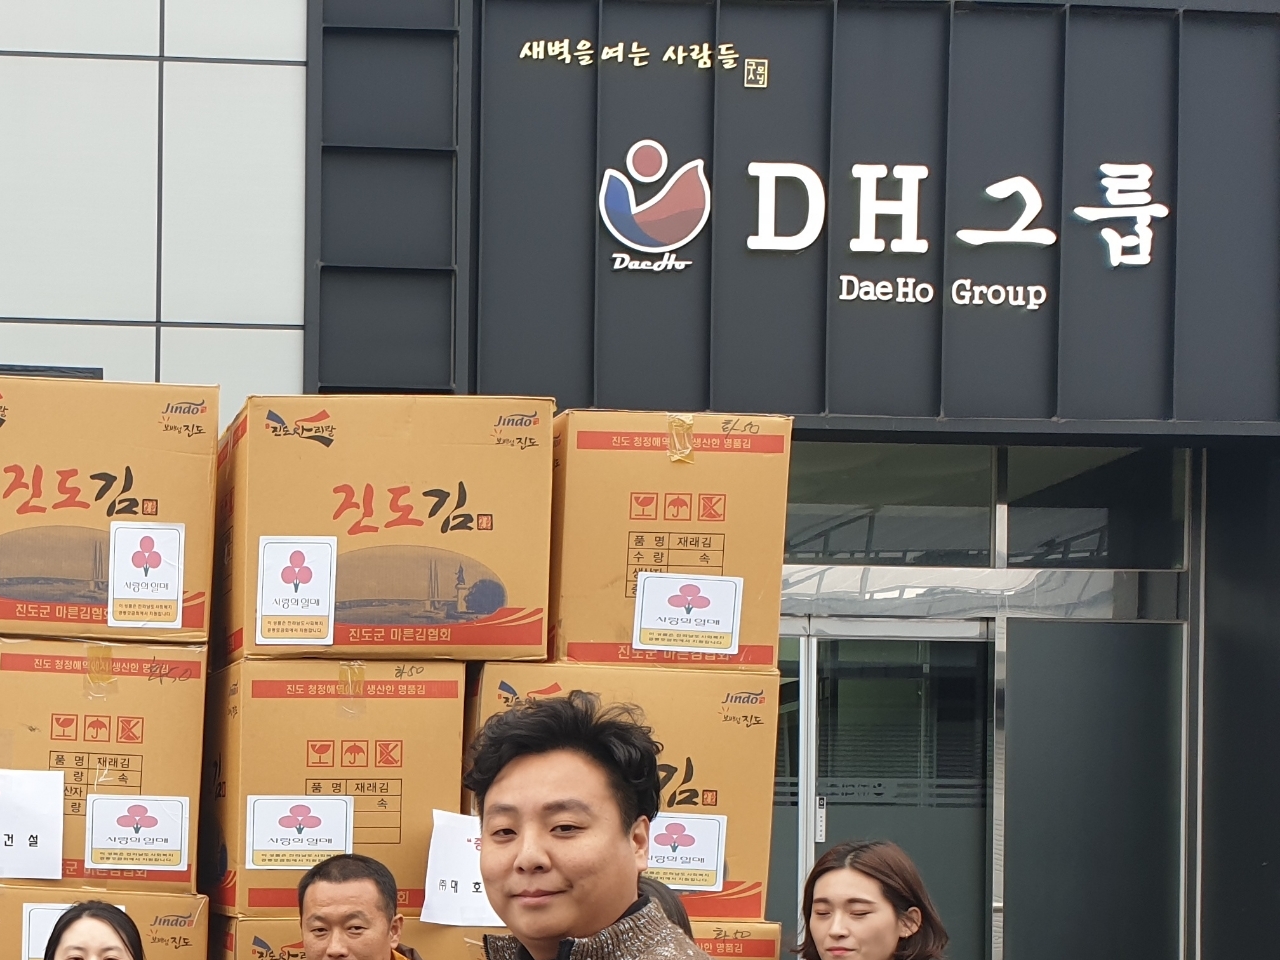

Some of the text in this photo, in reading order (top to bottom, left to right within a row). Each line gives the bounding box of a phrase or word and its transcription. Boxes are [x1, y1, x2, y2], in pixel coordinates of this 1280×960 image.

[518, 38, 740, 70] 새벽을 여는 사람들
[746, 161, 1170, 268] DH그룹
[838, 275, 1048, 311] DaeHo Group
[161, 400, 200, 416] Jindo
[493, 413, 532, 428] Jindo
[183, 423, 207, 438] 진도
[516, 436, 539, 450] 진도
[611, 436, 629, 447] 진도
[692, 438, 720, 449] 생산한
[723, 438, 751, 449] 명품김
[2, 463, 140, 517] 진도김
[332, 480, 475, 535] 진도김
[633, 535, 712, 548] 품 명 재래김
[632, 551, 711, 564] 수 량 속
[123, 581, 149, 593] 사랑의
[272, 598, 299, 609] 사랑의
[15, 604, 51, 619] 진도군
[655, 616, 692, 626] 사랑의
[348, 628, 452, 642] 진도군 마른김협회
[33, 658, 52, 669] 진도
[112, 661, 140, 673] 생산한
[286, 684, 305, 695] 진도
[366, 684, 395, 695] 생산한
[398, 684, 426, 695] 명품김
[721, 692, 759, 705] Jindo
[742, 714, 764, 728] 진도
[54, 755, 130, 769] 품 명 재래김
[117, 772, 129, 784] 속
[63, 785, 83, 797] 산자
[311, 781, 390, 793] 품 명 재래김
[376, 798, 389, 810] 속
[105, 836, 141, 845] 사랑의
[266, 836, 304, 845] 사랑의
[149, 914, 187, 928] Jindo
[170, 934, 193, 949] 진도
[716, 943, 743, 954] 명품김
